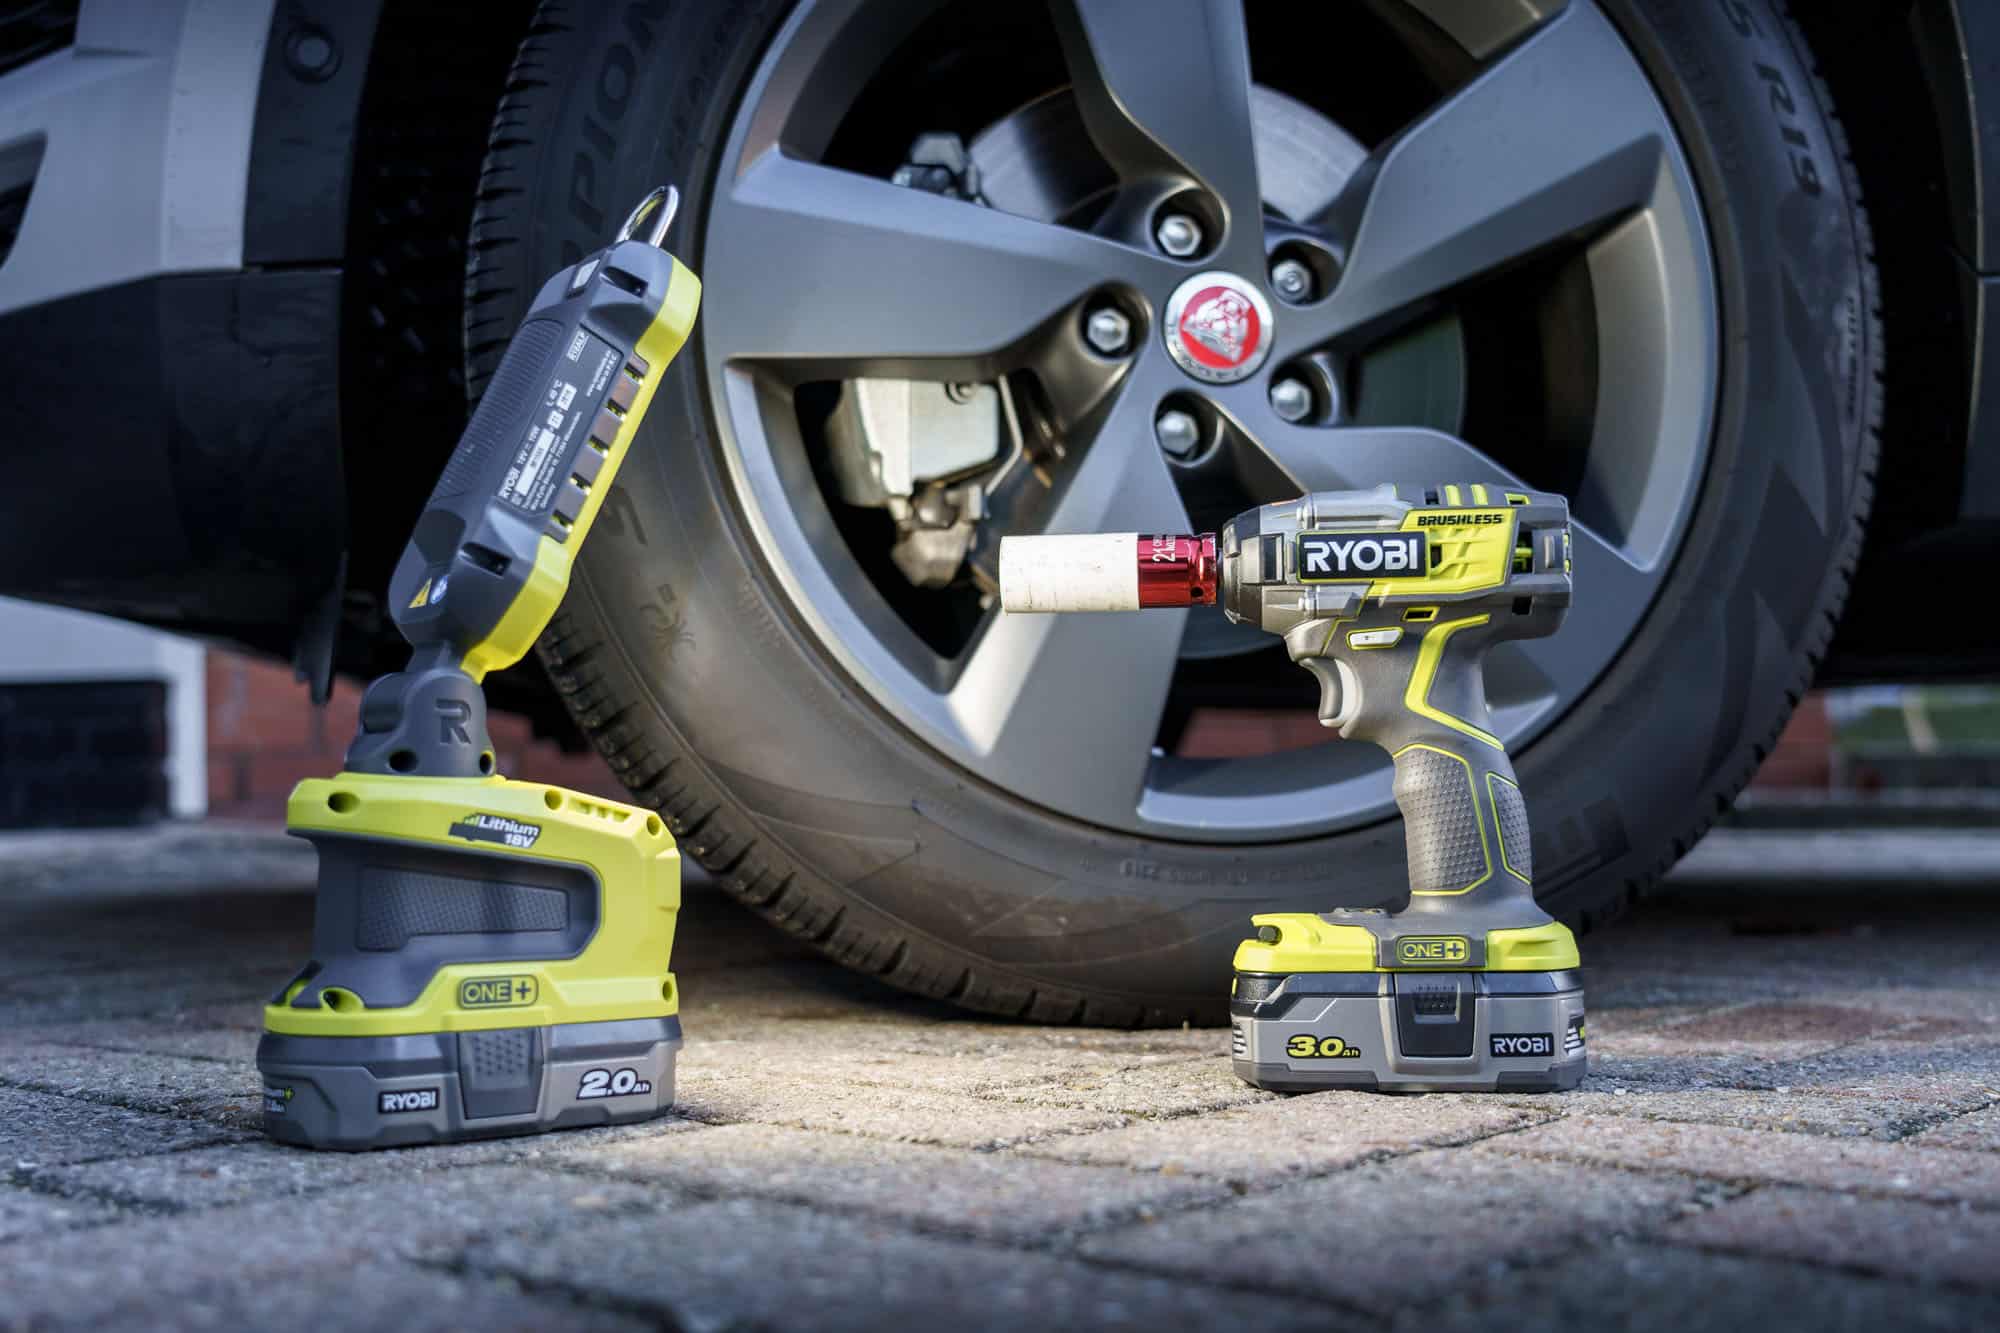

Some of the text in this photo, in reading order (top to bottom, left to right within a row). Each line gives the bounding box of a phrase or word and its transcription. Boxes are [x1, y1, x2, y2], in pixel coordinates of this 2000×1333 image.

[497, 466, 521, 499] RYOBI
[1417, 514, 1504, 527] BRUSHLESS
[1303, 539, 1418, 572] RYOBI
[434, 698, 472, 745] R
[477, 815, 540, 837] Lithium
[504, 832, 535, 847] 18V
[1402, 938, 1467, 961] ONE+
[463, 979, 533, 1004] ONE+
[1492, 1036, 1551, 1055] RYOBI
[382, 1090, 438, 1113] RYOBI
